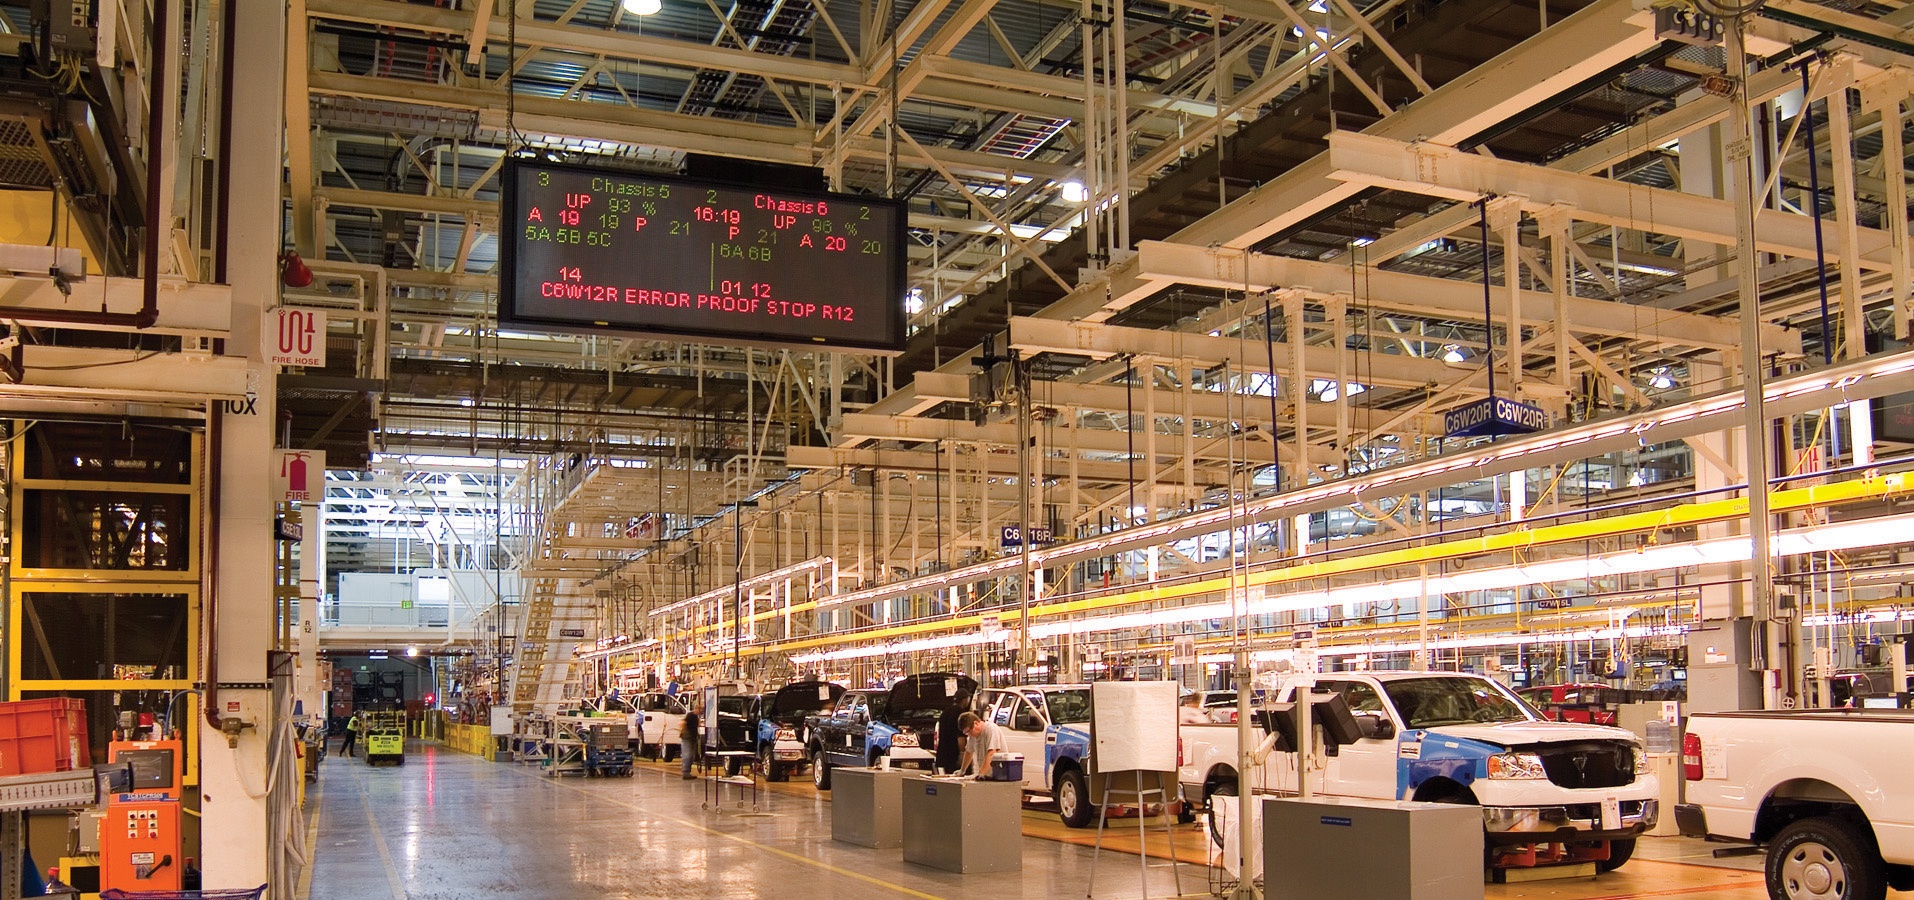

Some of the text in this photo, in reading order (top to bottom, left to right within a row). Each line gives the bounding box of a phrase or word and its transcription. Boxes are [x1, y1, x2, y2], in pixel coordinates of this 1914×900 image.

[538, 171, 870, 221] 3 Chassis 5 2 Chassis 6 2
[565, 193, 592, 209] UP
[608, 197, 631, 214] 93
[642, 200, 657, 216] %
[693, 206, 741, 225] 16:19
[773, 214, 797, 230] UP
[844, 221, 858, 237] %
[525, 225, 611, 247] 5A 5B 5C
[527, 206, 882, 255] A 19 19 P 21 P 21 A 20 20
[720, 243, 772, 262] 6A 6B
[559, 266, 582, 283] 14
[720, 280, 772, 298] 01 12
[541, 281, 854, 322] C6W12R ERROR PROOF STOP R12
[271, 356, 320, 366] FIRE HOSE
[1446, 401, 1492, 433] C6W20R
[1496, 400, 1544, 429] C6W20R
[285, 491, 310, 500] FIRE
[1004, 527, 1051, 542] C618R
